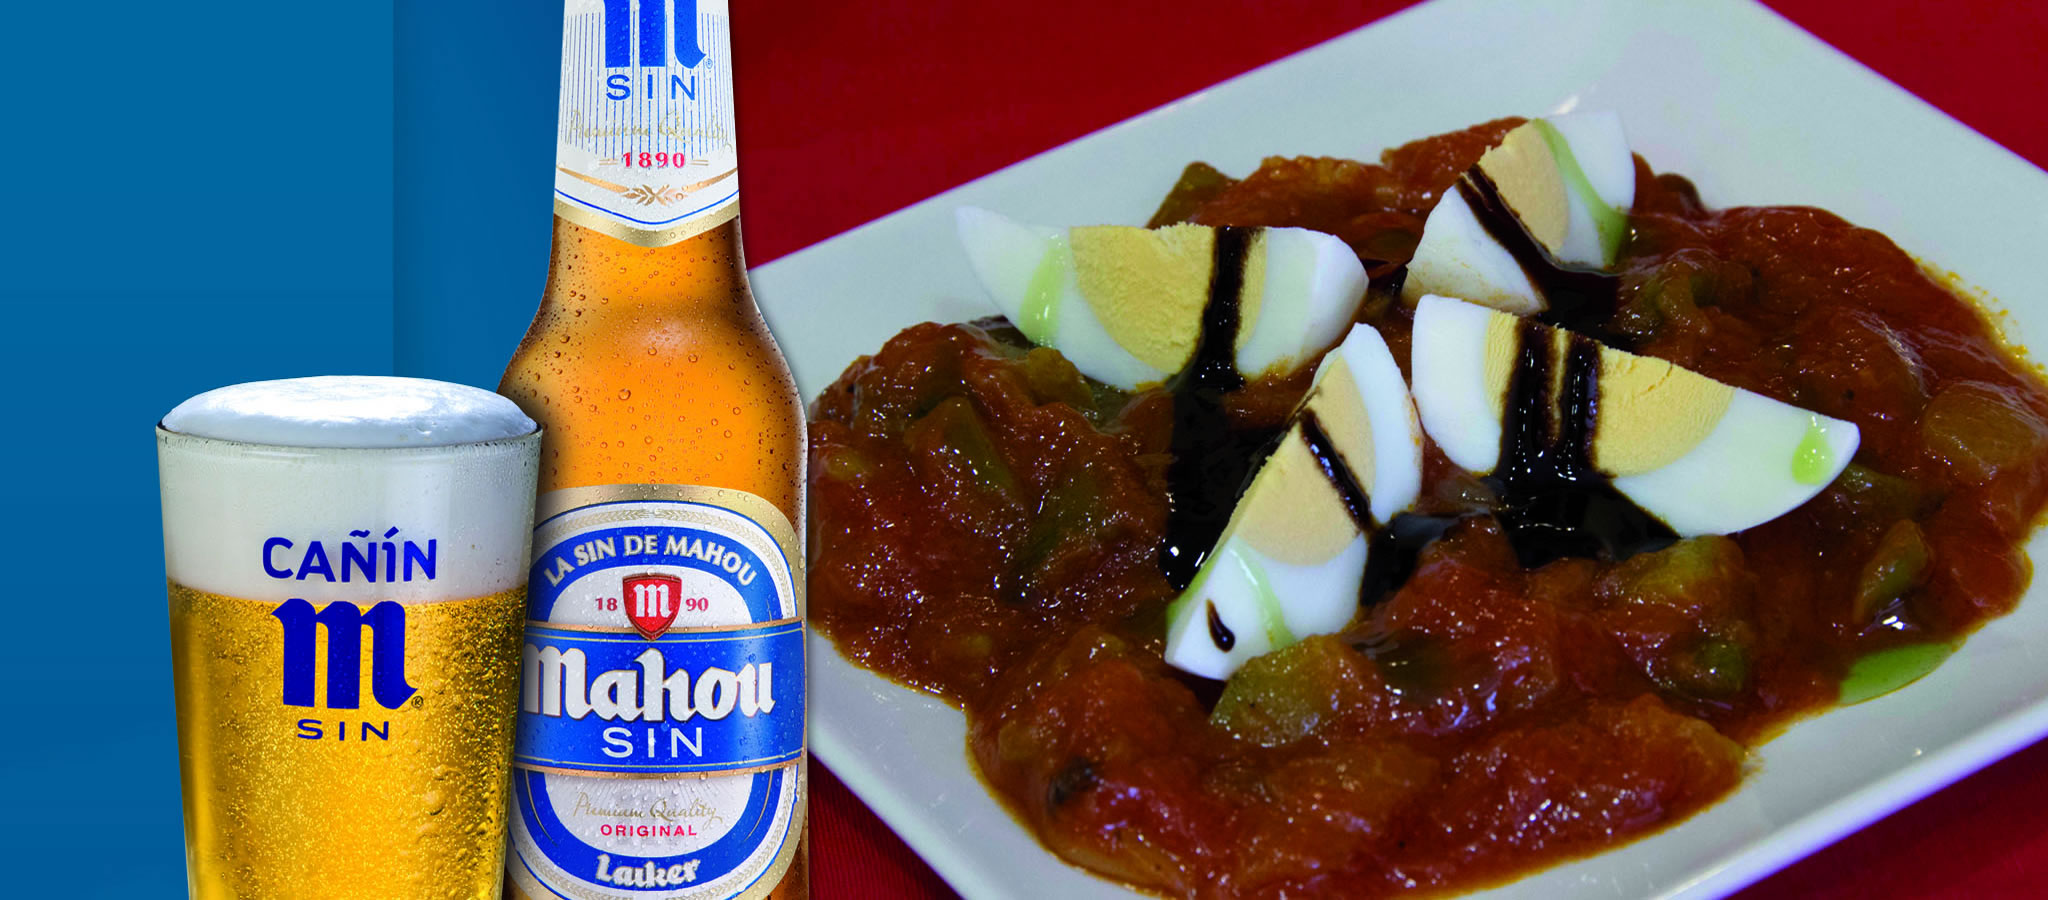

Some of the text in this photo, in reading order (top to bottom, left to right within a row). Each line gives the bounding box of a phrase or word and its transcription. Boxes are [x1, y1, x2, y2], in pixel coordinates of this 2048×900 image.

[606, 74, 696, 101] SIN
[622, 152, 686, 169] 1890
[262, 526, 437, 583] CAÑÍN
[544, 535, 757, 587] LA SIN DE MAHOU
[595, 597, 709, 612] 18 90
[523, 643, 776, 722] Mahou
[297, 719, 389, 741] SIN
[602, 727, 703, 758] SIN
[572, 791, 723, 830] Premium Quality
[600, 824, 698, 837] ORIGINAL
